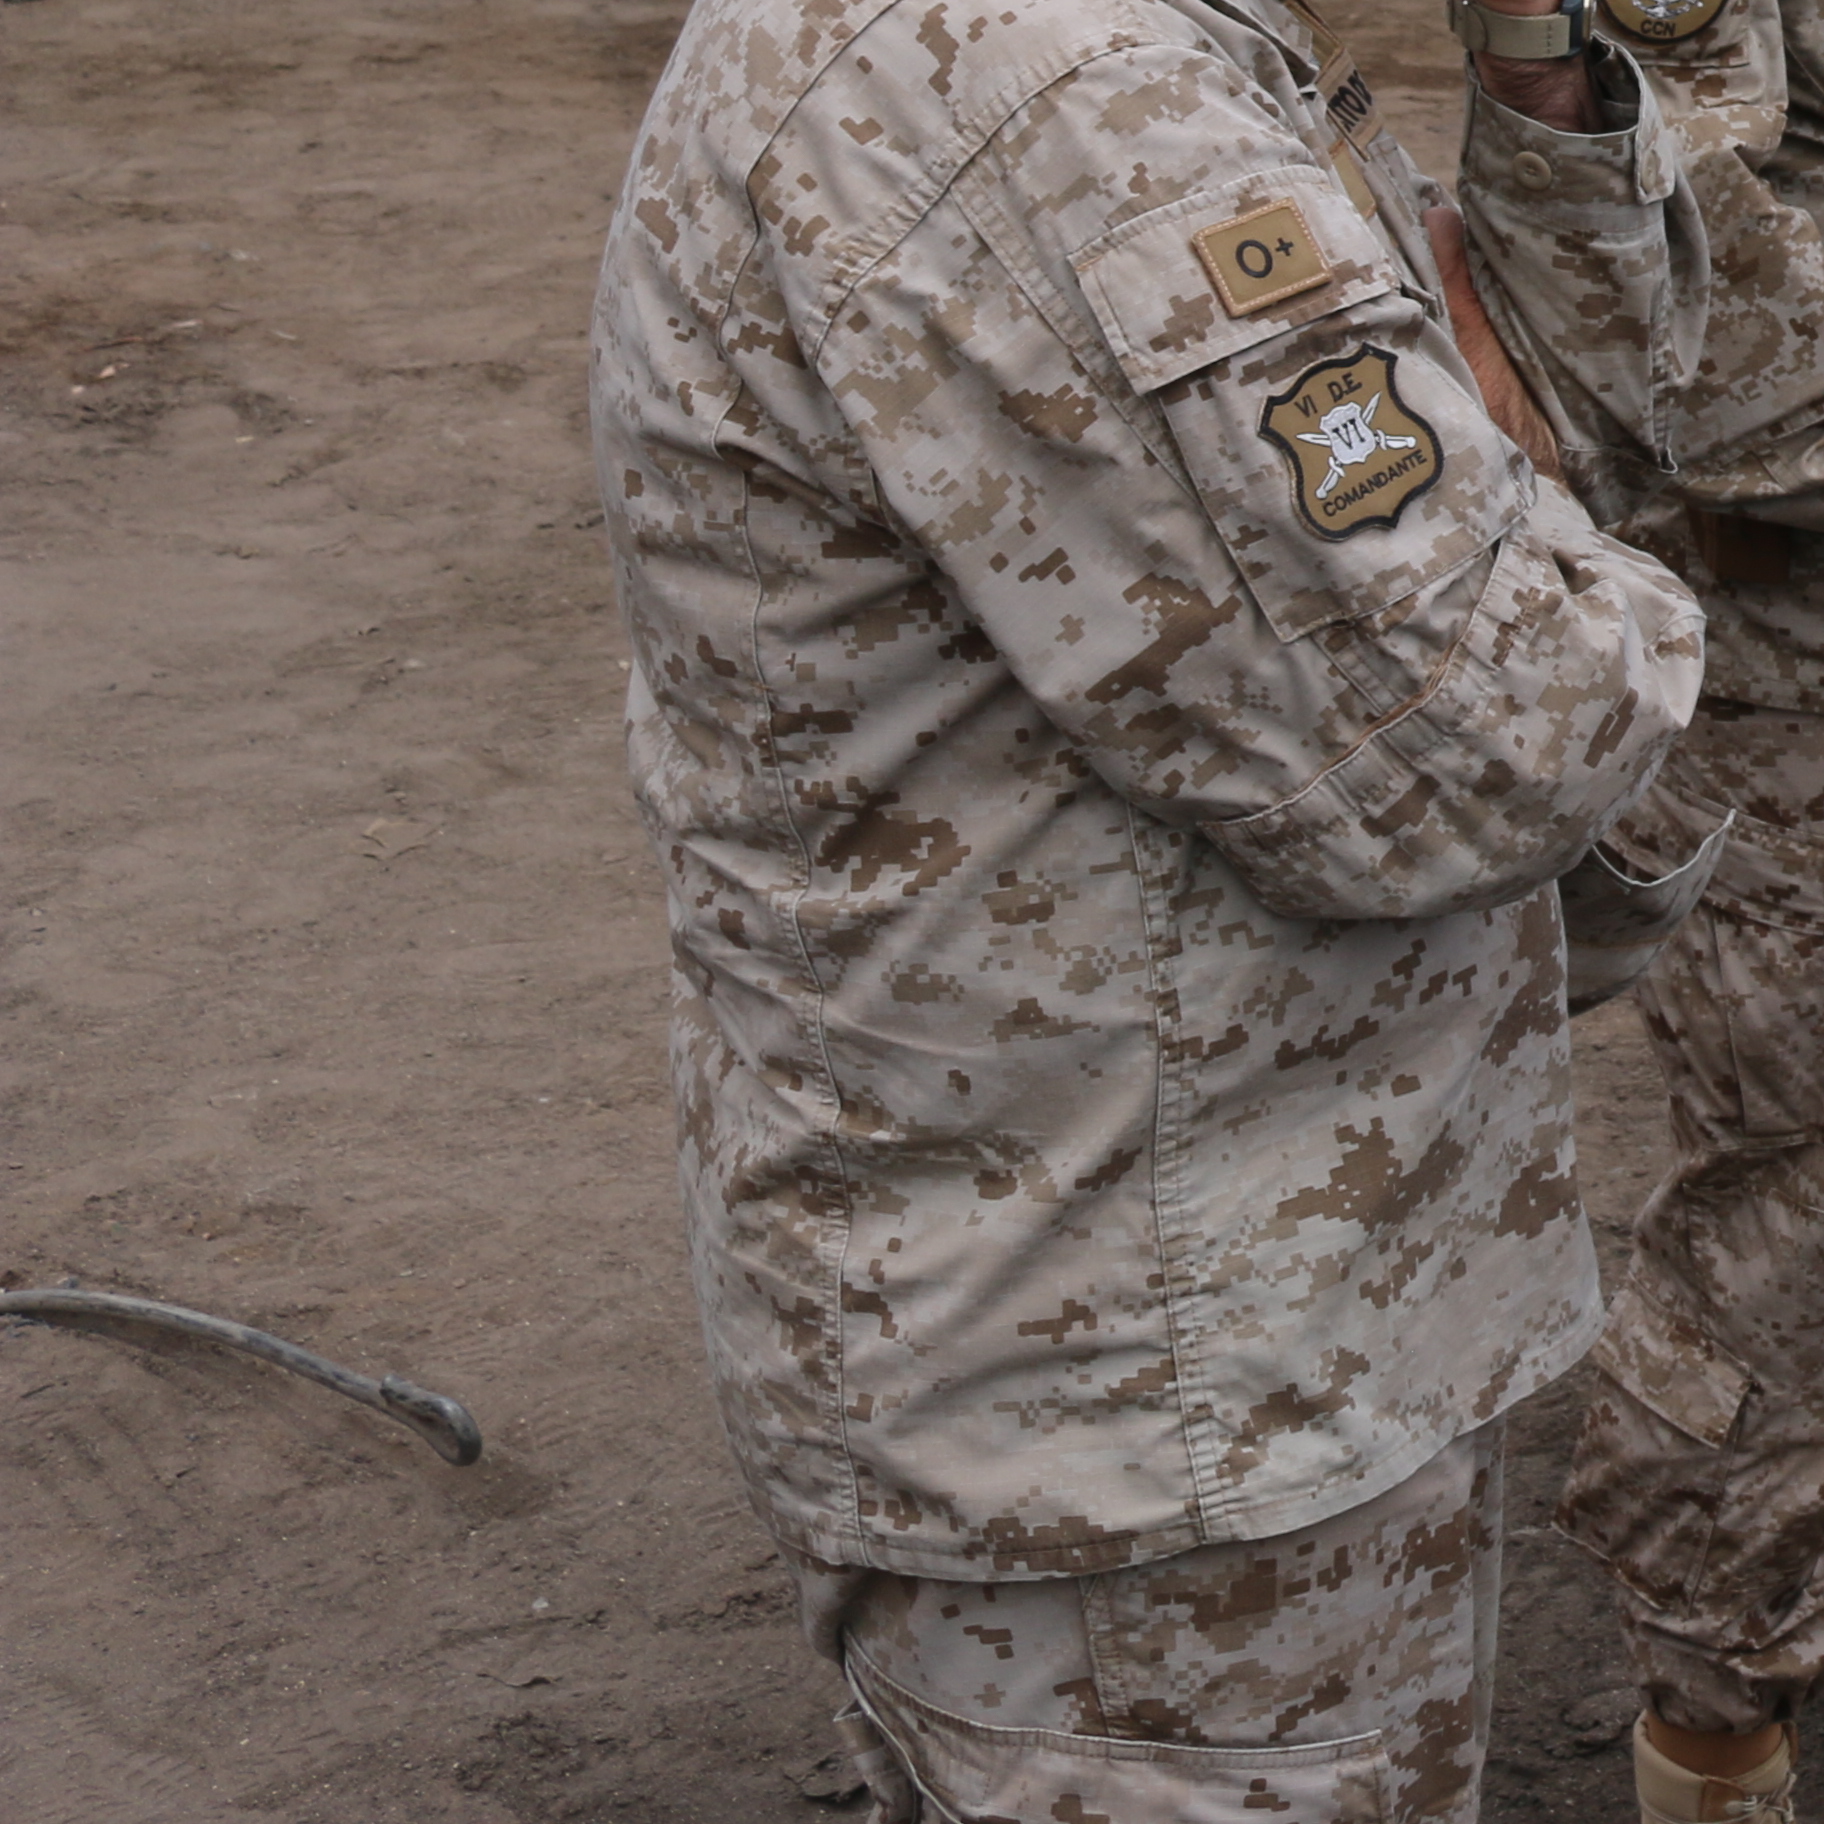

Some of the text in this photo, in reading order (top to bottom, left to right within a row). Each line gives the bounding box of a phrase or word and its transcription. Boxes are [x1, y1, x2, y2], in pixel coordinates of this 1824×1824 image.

[1640, 19, 1676, 37] CCN
[1236, 238, 1294, 279] O+
[1294, 394, 1319, 418] VI
[1332, 418, 1366, 449] VI
[1322, 449, 1428, 516] COMANDANTE
